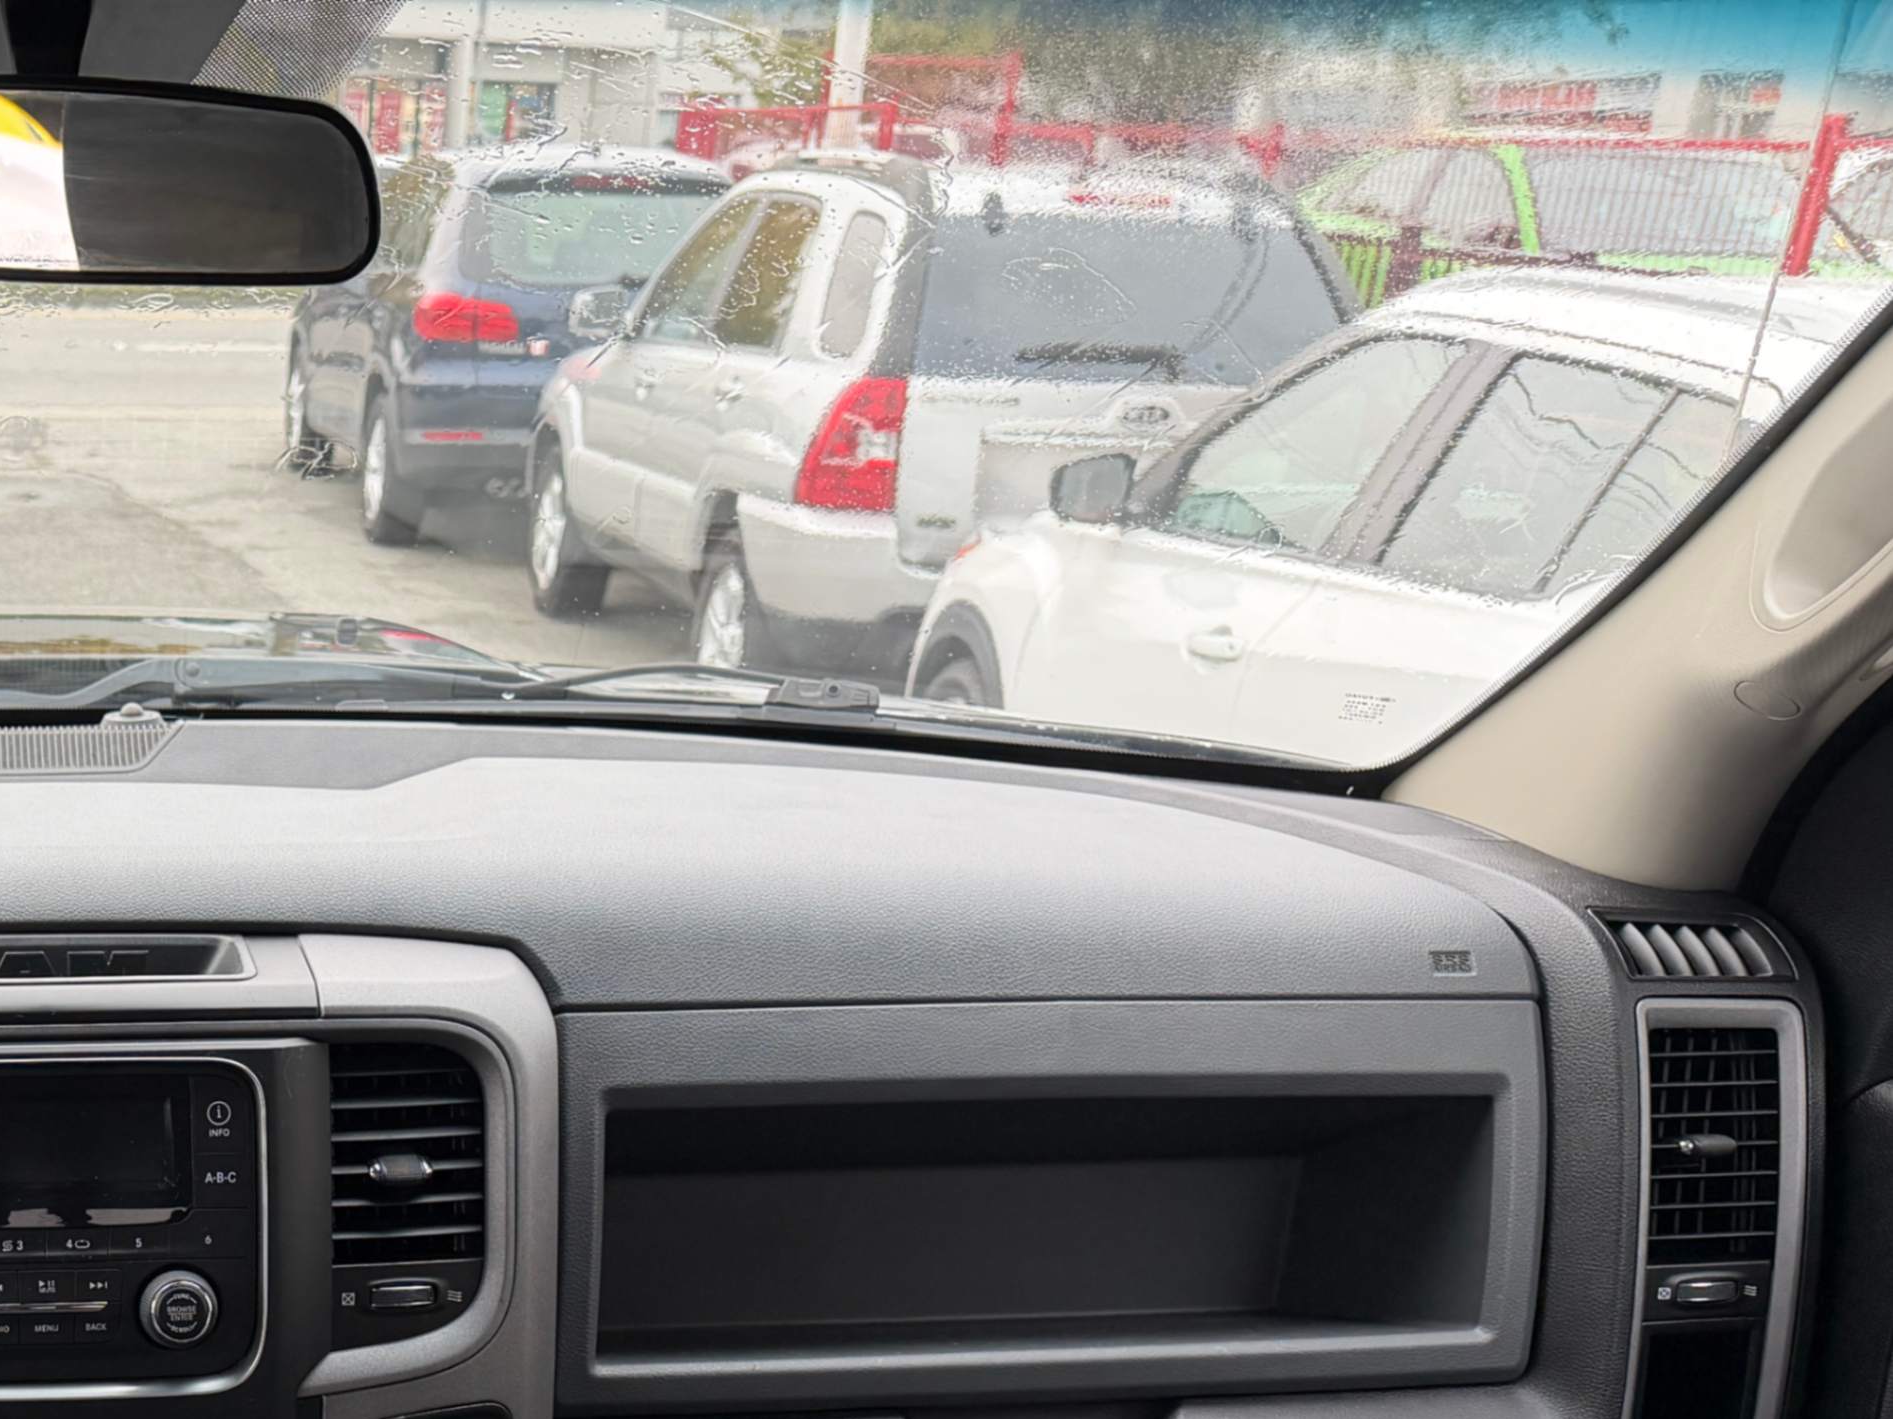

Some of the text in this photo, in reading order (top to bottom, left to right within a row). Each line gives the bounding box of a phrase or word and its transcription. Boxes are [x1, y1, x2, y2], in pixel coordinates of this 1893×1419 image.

[208, 1127, 230, 1137] INFO
[66, 1239, 73, 1249] 4
[135, 1238, 143, 1248] 5
[205, 1235, 212, 1245] 6
[16, 1241, 24, 1251] 3
[34, 1324, 59, 1333] MENU
[85, 1322, 107, 1331] BACK
